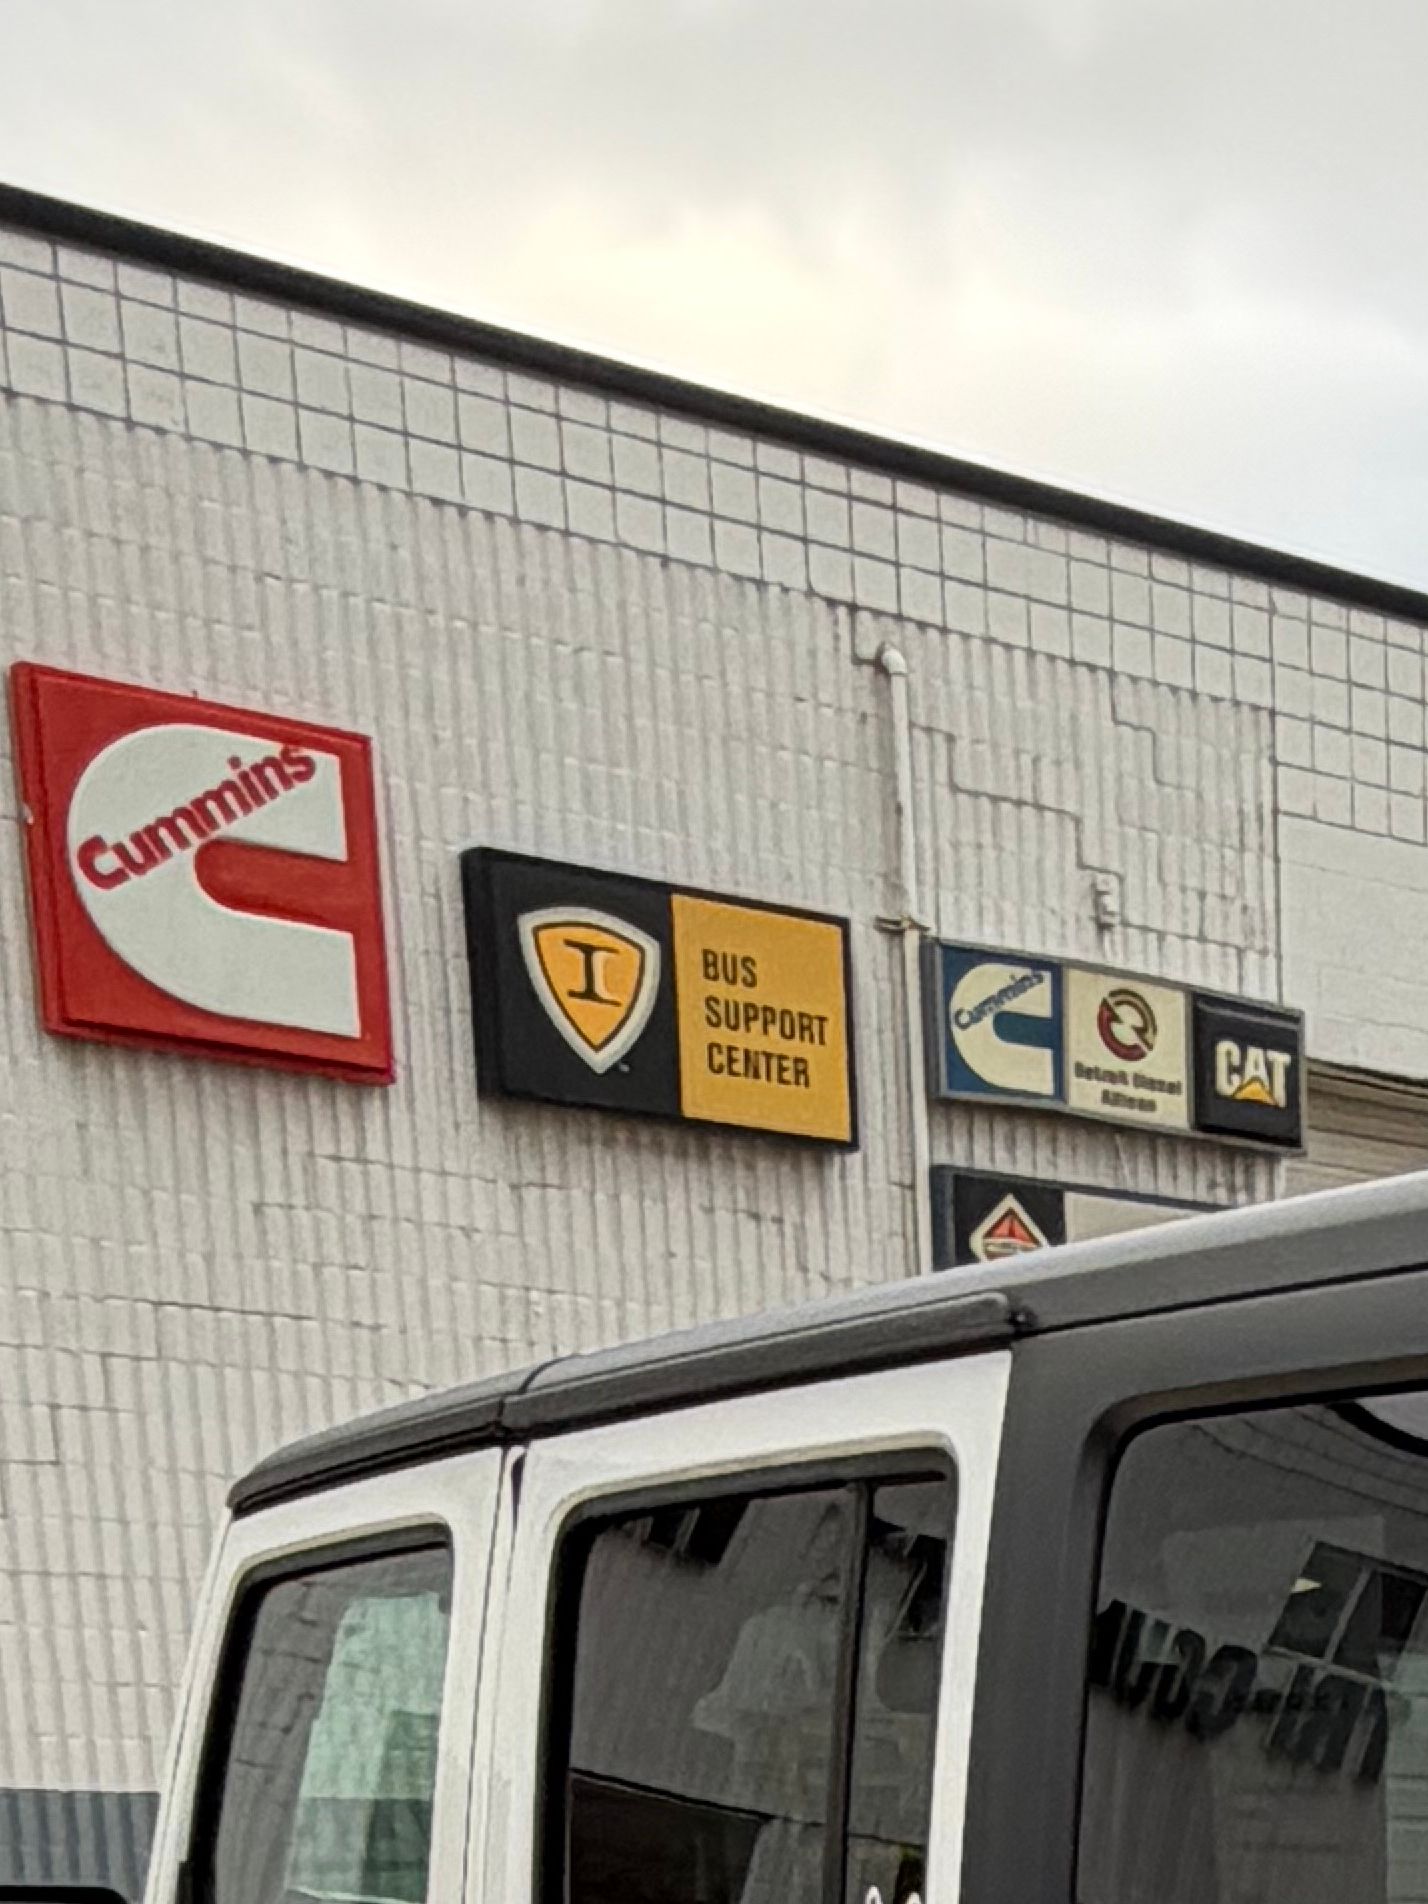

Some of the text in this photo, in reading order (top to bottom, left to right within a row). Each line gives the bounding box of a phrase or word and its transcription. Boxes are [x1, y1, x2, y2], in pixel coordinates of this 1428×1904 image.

[77, 744, 317, 890] Cummins
[702, 948, 758, 988] BUS
[704, 995, 829, 1046] SUPPORT
[707, 1042, 810, 1088] CENTER
[1215, 1039, 1292, 1108] CAT
